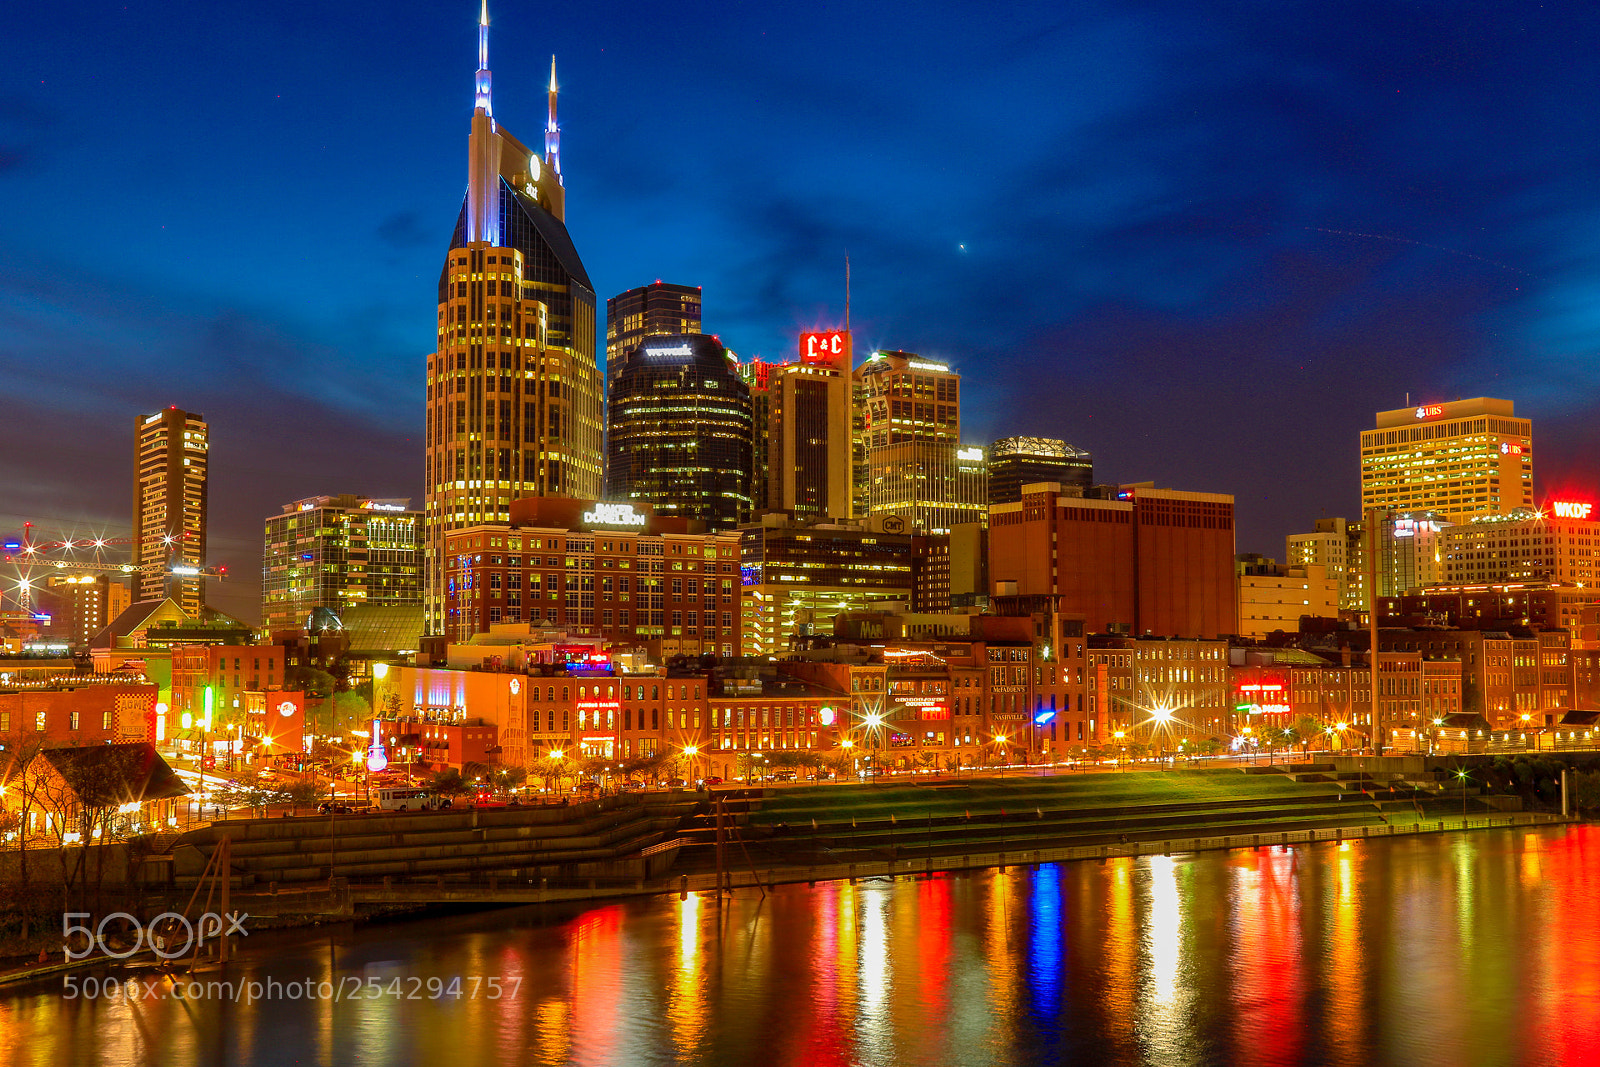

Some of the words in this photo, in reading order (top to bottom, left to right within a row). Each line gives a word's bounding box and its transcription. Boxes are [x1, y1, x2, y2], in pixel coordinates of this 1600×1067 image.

[1425, 406, 1442, 416] UBS
[1508, 445, 1522, 454] UBS
[1553, 501, 1593, 519] WKDF
[885, 521, 902, 531] CMT
